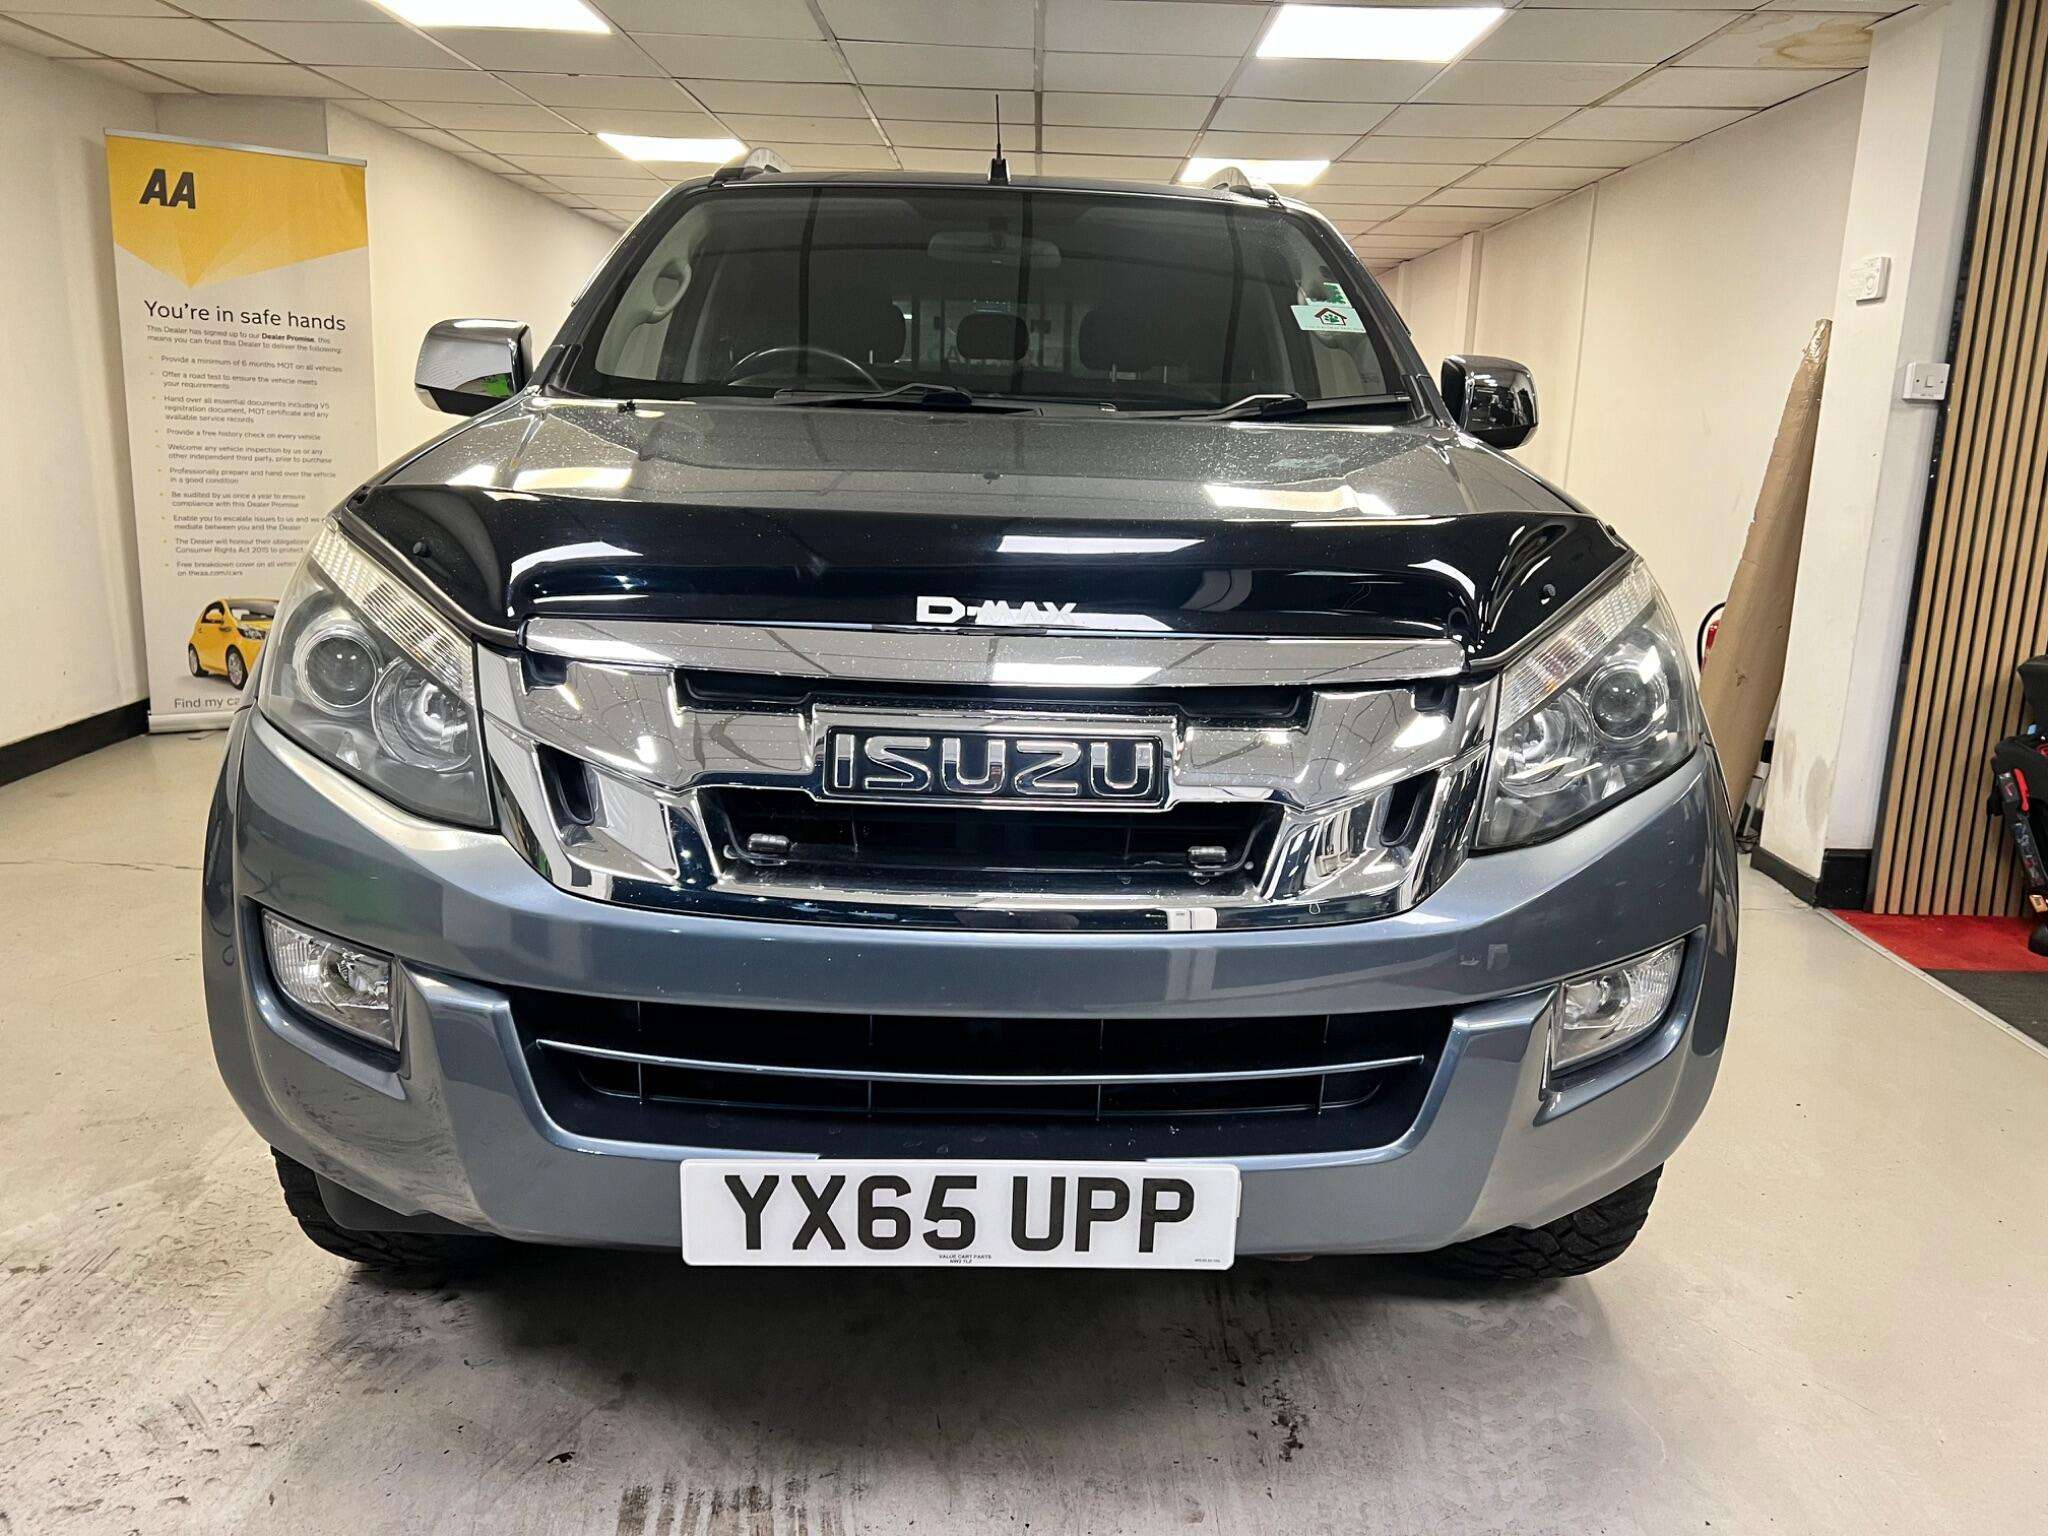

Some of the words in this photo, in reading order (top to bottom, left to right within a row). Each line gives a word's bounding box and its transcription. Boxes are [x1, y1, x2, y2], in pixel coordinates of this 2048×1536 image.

[139, 168, 197, 209] AA
[144, 300, 209, 320] You're
[217, 306, 233, 322] in
[240, 309, 281, 325] safe
[288, 311, 345, 330] hands
[164, 326, 188, 334] Dealer
[203, 328, 228, 338] signed
[262, 332, 285, 341] Dealer
[238, 340, 261, 348] Dealer
[271, 342, 295, 350] deliver
[161, 355, 189, 363] Provide
[197, 357, 231, 366] minimum
[248, 360, 275, 368] months
[315, 364, 342, 372] vehicles
[181, 380, 230, 390] requirements
[271, 376, 295, 385] vehicle
[164, 404, 206, 413] registration
[213, 397, 246, 405] essential
[247, 399, 286, 407] documents
[288, 401, 318, 410] including
[218, 430, 242, 439] history
[245, 446, 281, 455] inspection
[282, 447, 291, 455] by
[189, 453, 234, 462] independent
[275, 455, 292, 464] prior
[302, 456, 332, 465] purchase
[169, 467, 219, 476] Professionally
[185, 476, 204, 484] good
[212, 492, 221, 500] by
[172, 500, 214, 508] compliance
[916, 596, 1078, 624] D-MAX
[174, 698, 201, 708] Find
[205, 699, 223, 708] my
[834, 732, 1154, 796] ISUZU
[724, 1174, 977, 1251] YX65
[1011, 1176, 1195, 1253] UPP
